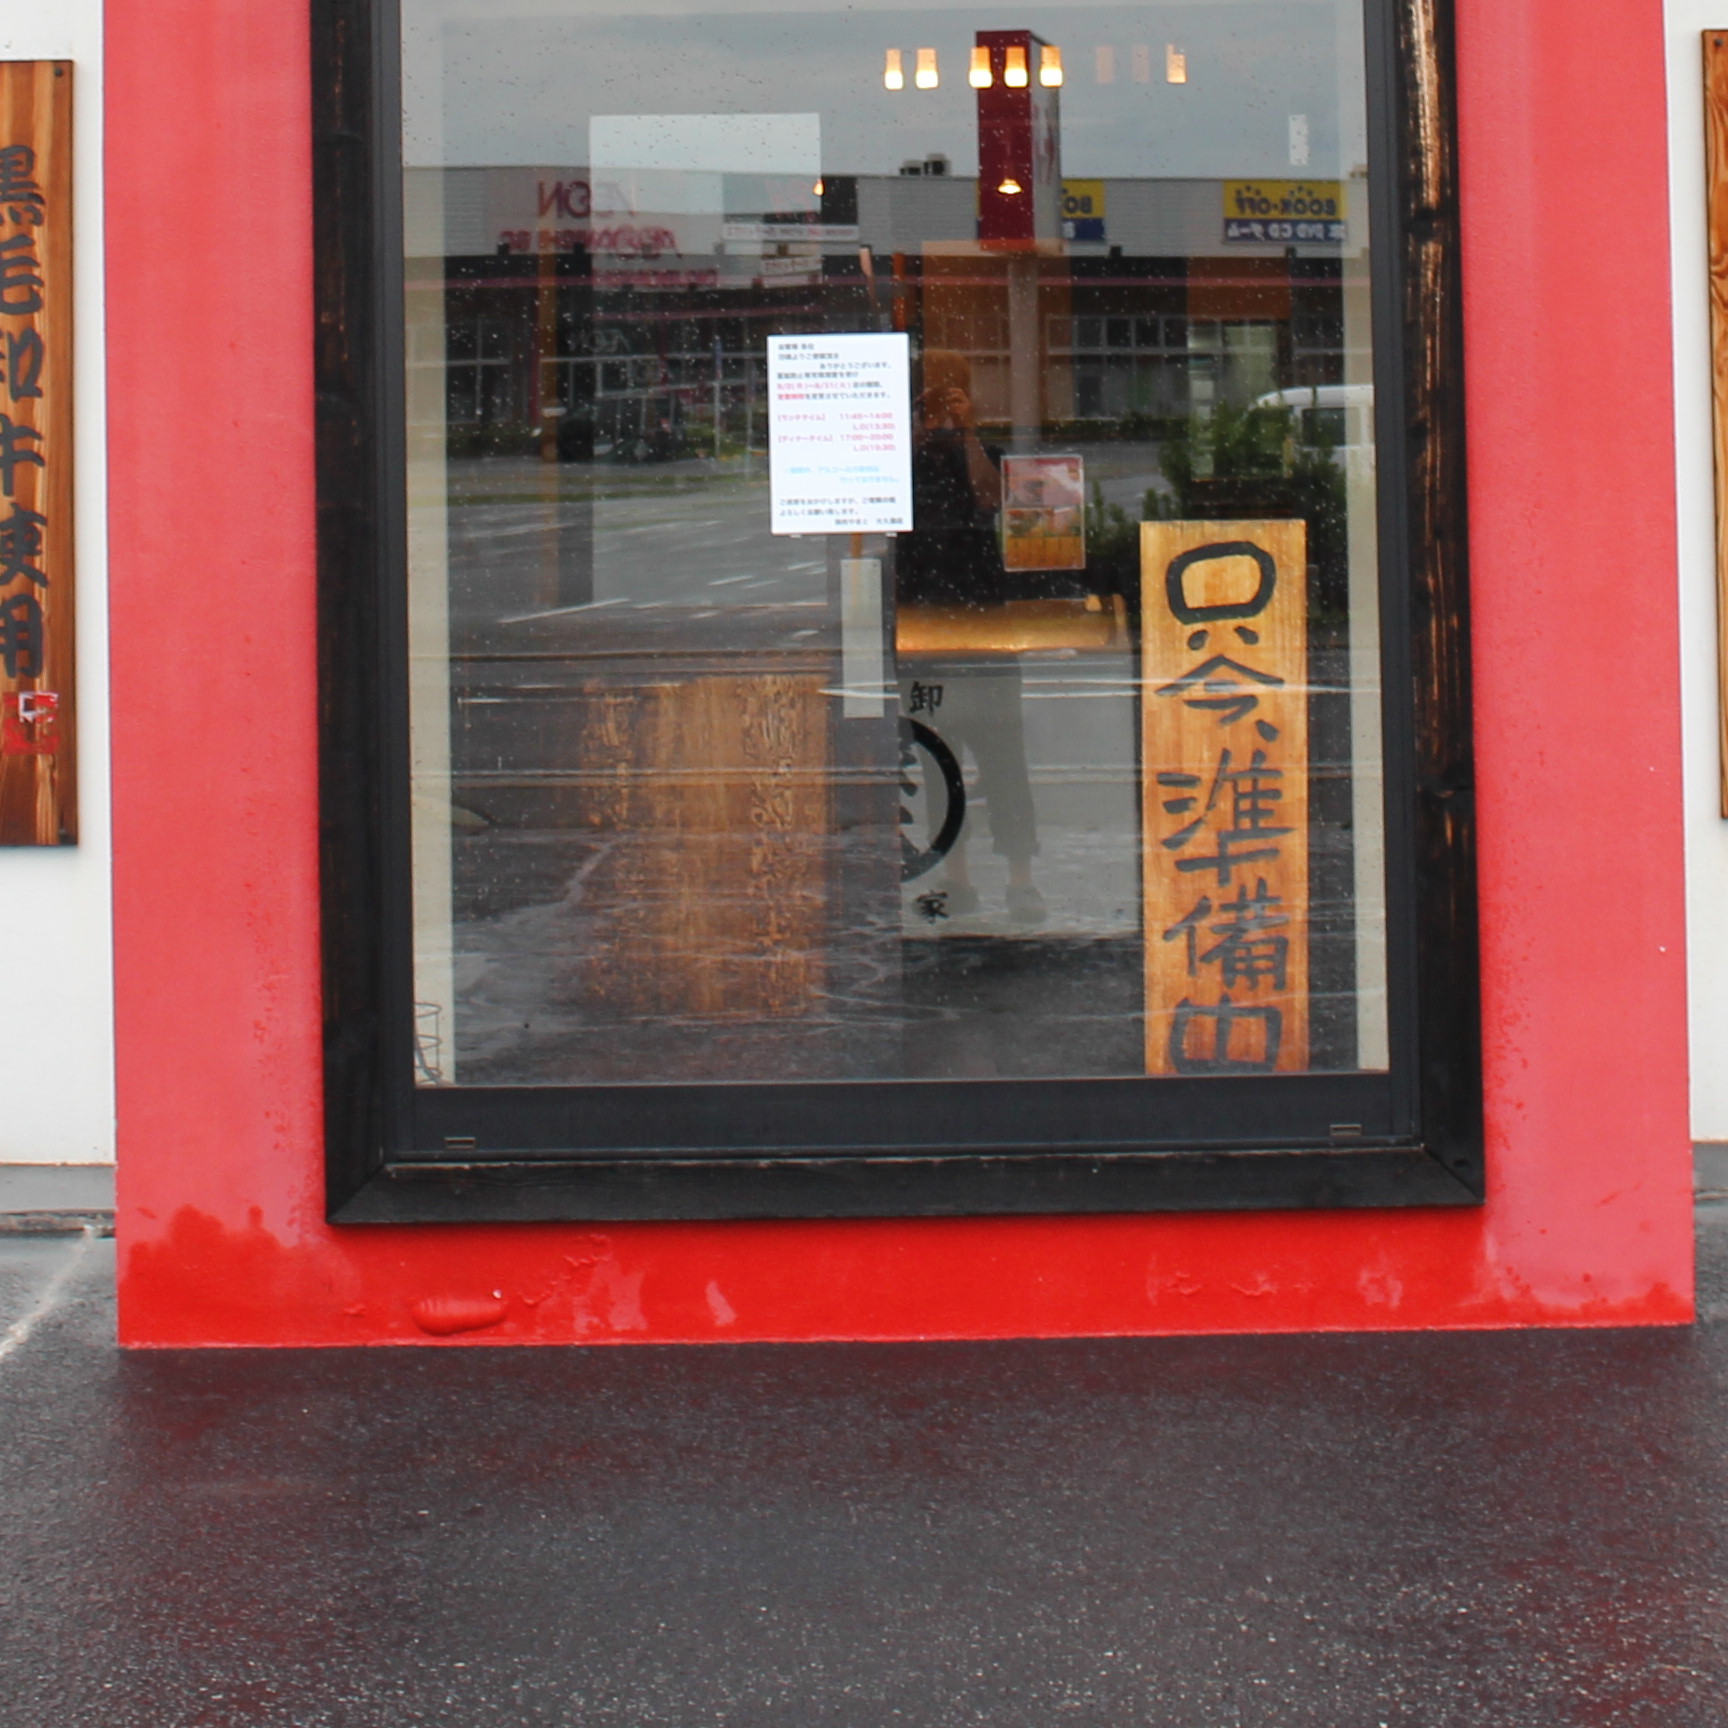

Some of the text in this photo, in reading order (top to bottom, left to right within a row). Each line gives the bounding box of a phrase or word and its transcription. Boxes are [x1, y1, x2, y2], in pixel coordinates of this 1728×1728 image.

[1154, 540, 1295, 1071] 只今準備中
